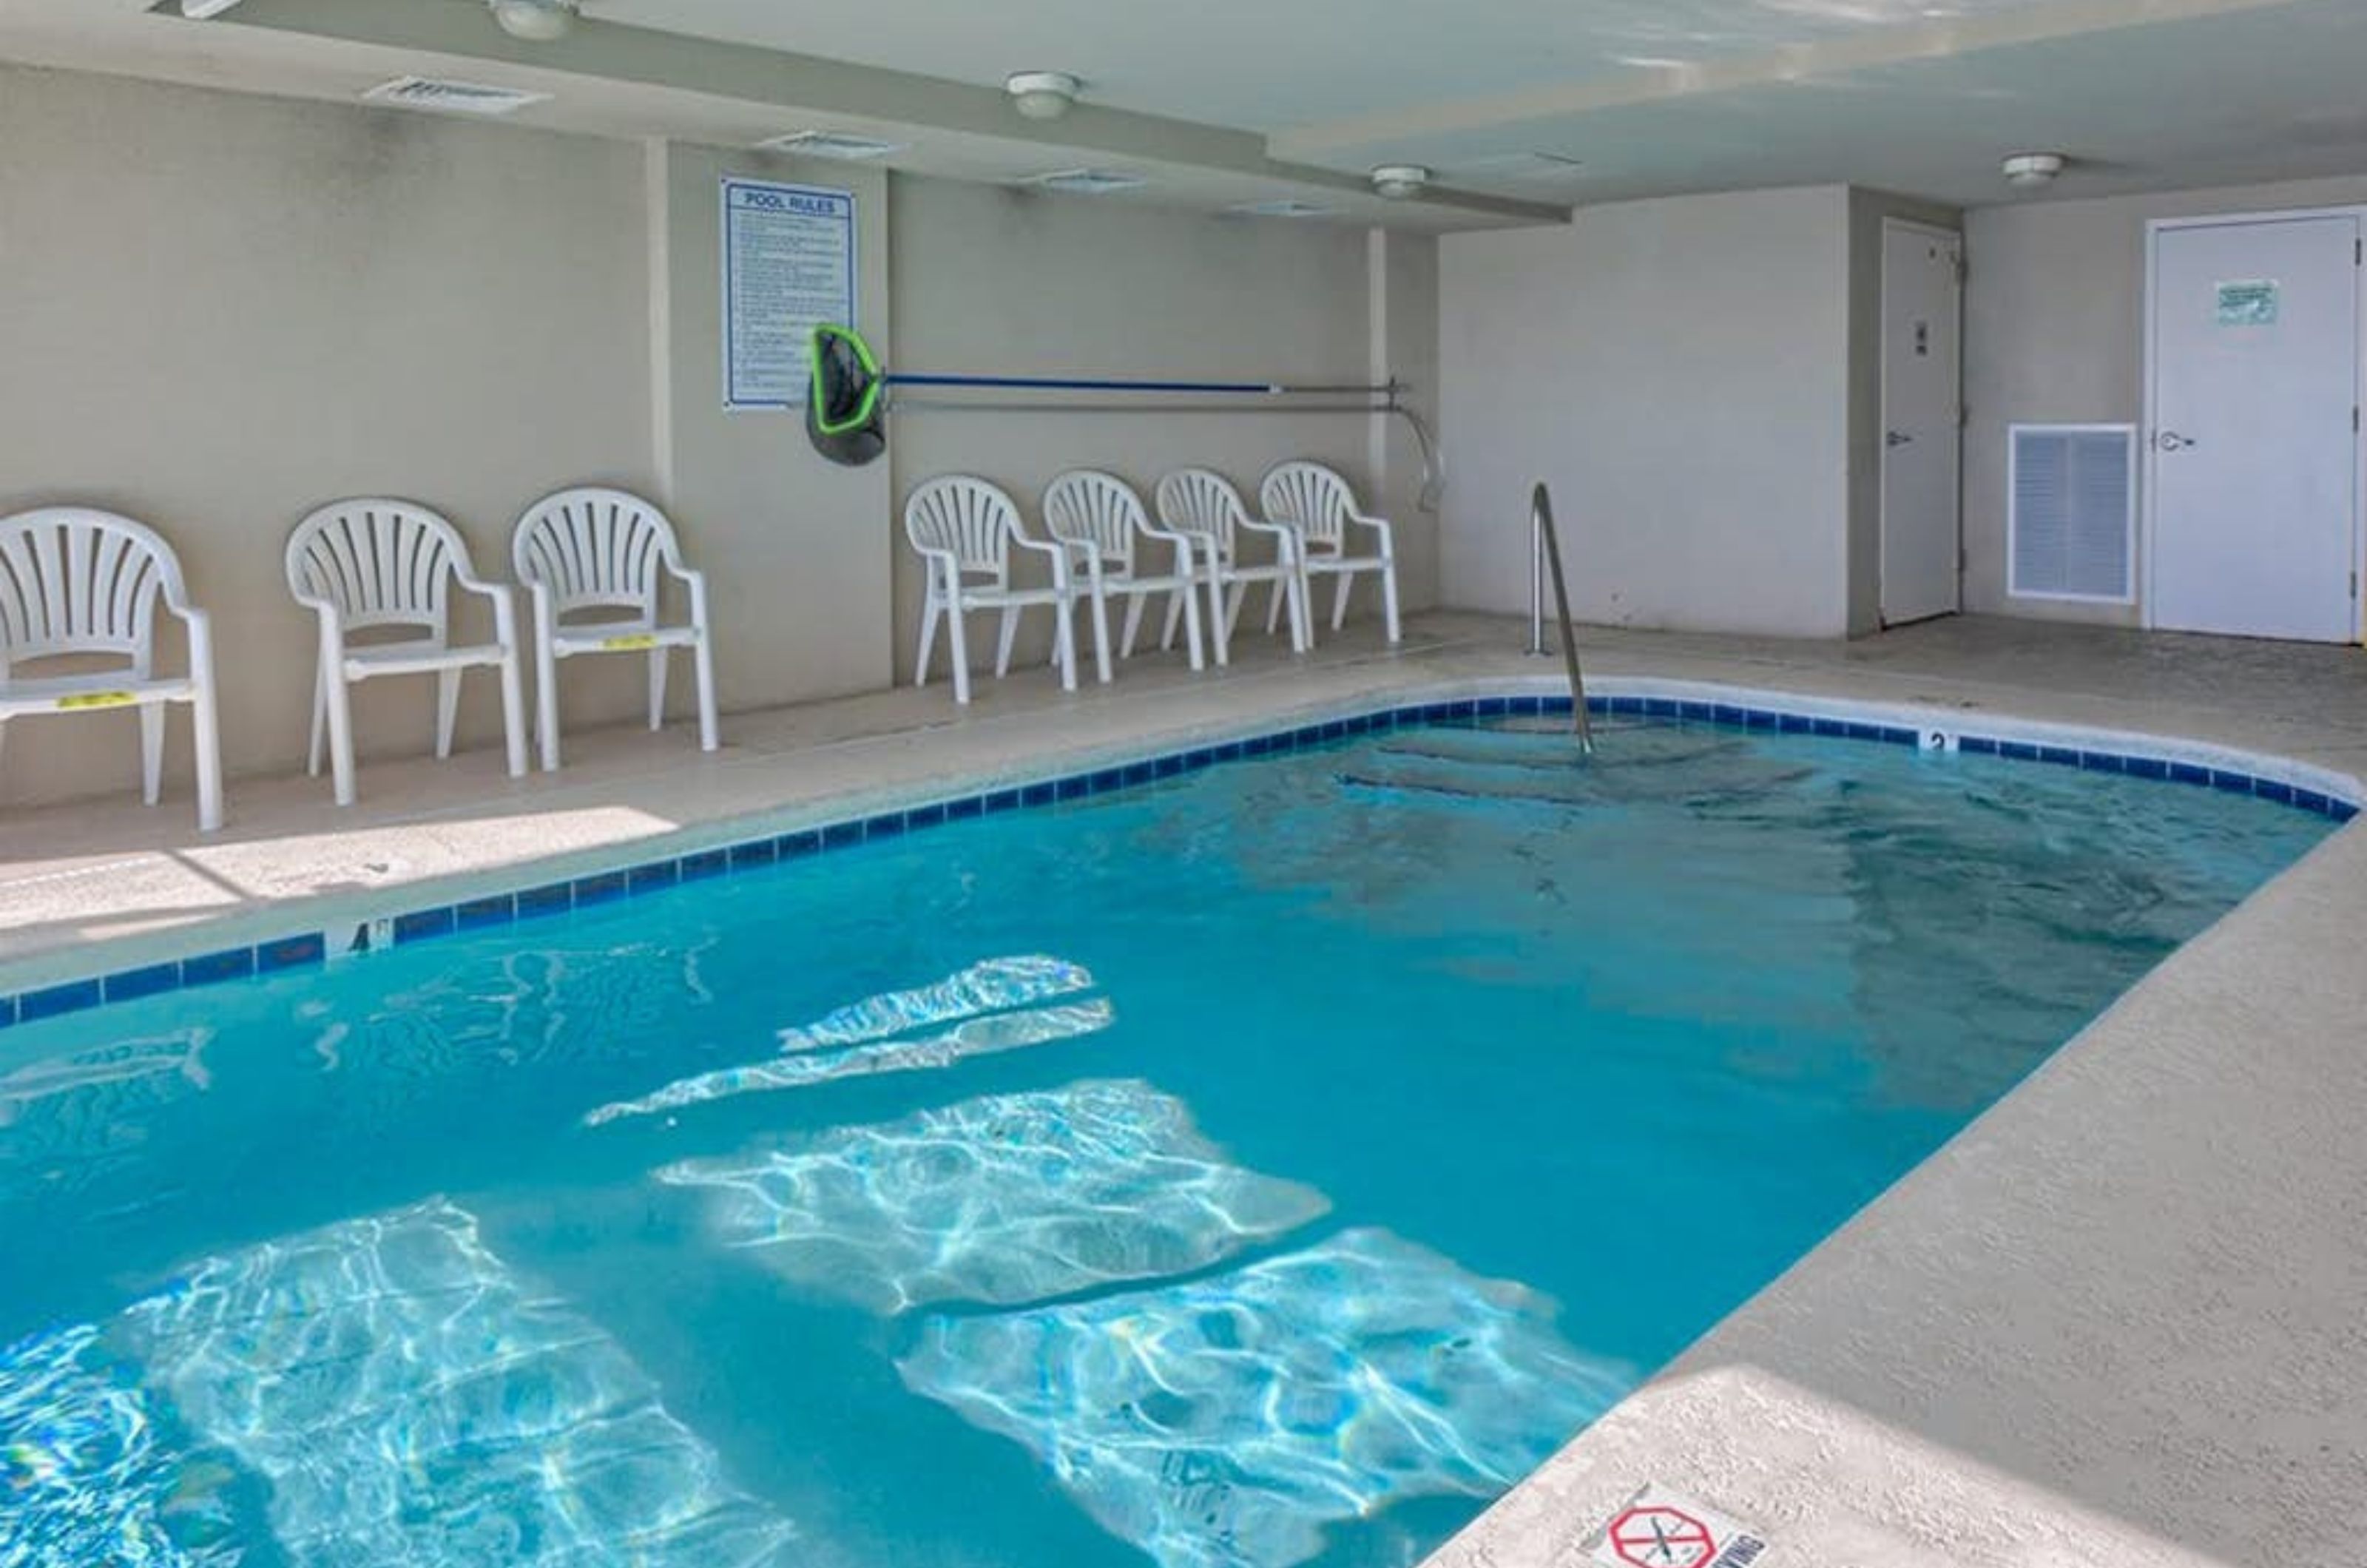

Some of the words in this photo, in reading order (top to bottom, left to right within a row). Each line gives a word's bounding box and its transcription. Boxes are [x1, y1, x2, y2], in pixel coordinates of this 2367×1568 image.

[743, 192, 785, 208] POOL
[789, 197, 836, 214] RULES
[346, 922, 371, 953] 4
